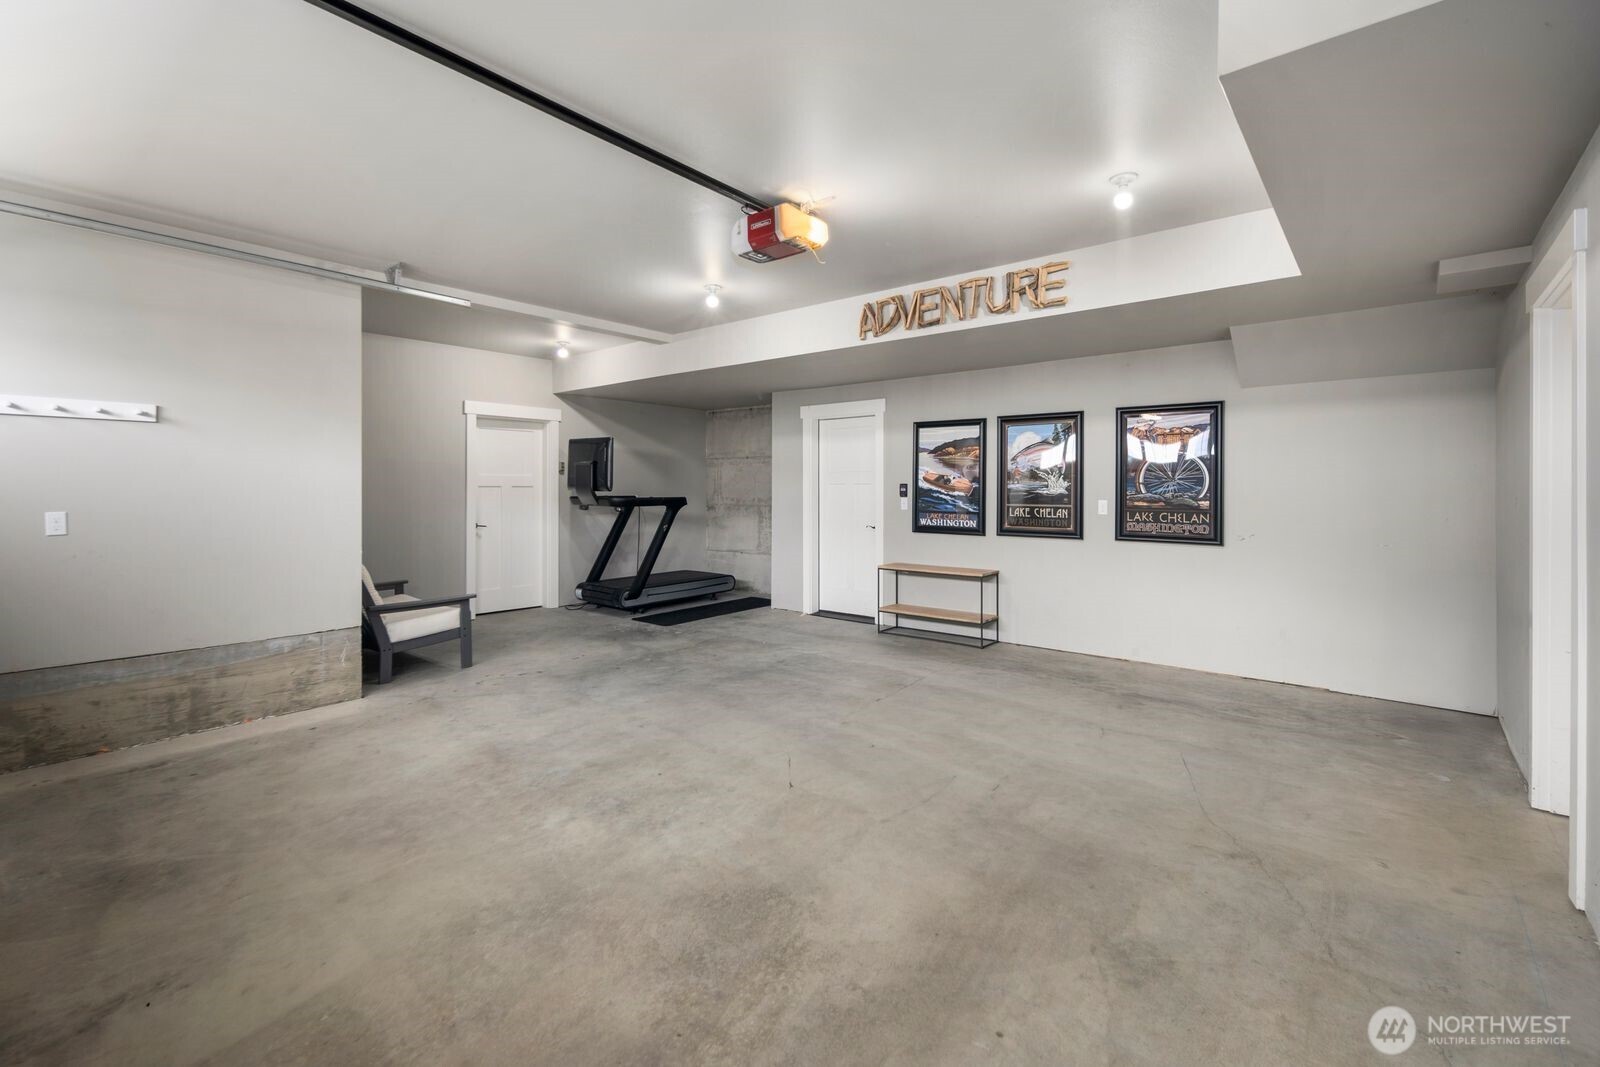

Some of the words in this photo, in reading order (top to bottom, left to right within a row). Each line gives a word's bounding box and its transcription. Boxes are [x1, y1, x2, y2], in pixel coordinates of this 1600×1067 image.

[859, 260, 1072, 340] ADVENTURE
[1009, 507, 1031, 517] LAKE
[1034, 508, 1068, 518] CHELAN
[1127, 511, 1154, 522] LAKE
[1159, 512, 1210, 523] CHELAN
[919, 518, 977, 528] WASHINGTON
[1009, 517, 1068, 527] WASHINGTON
